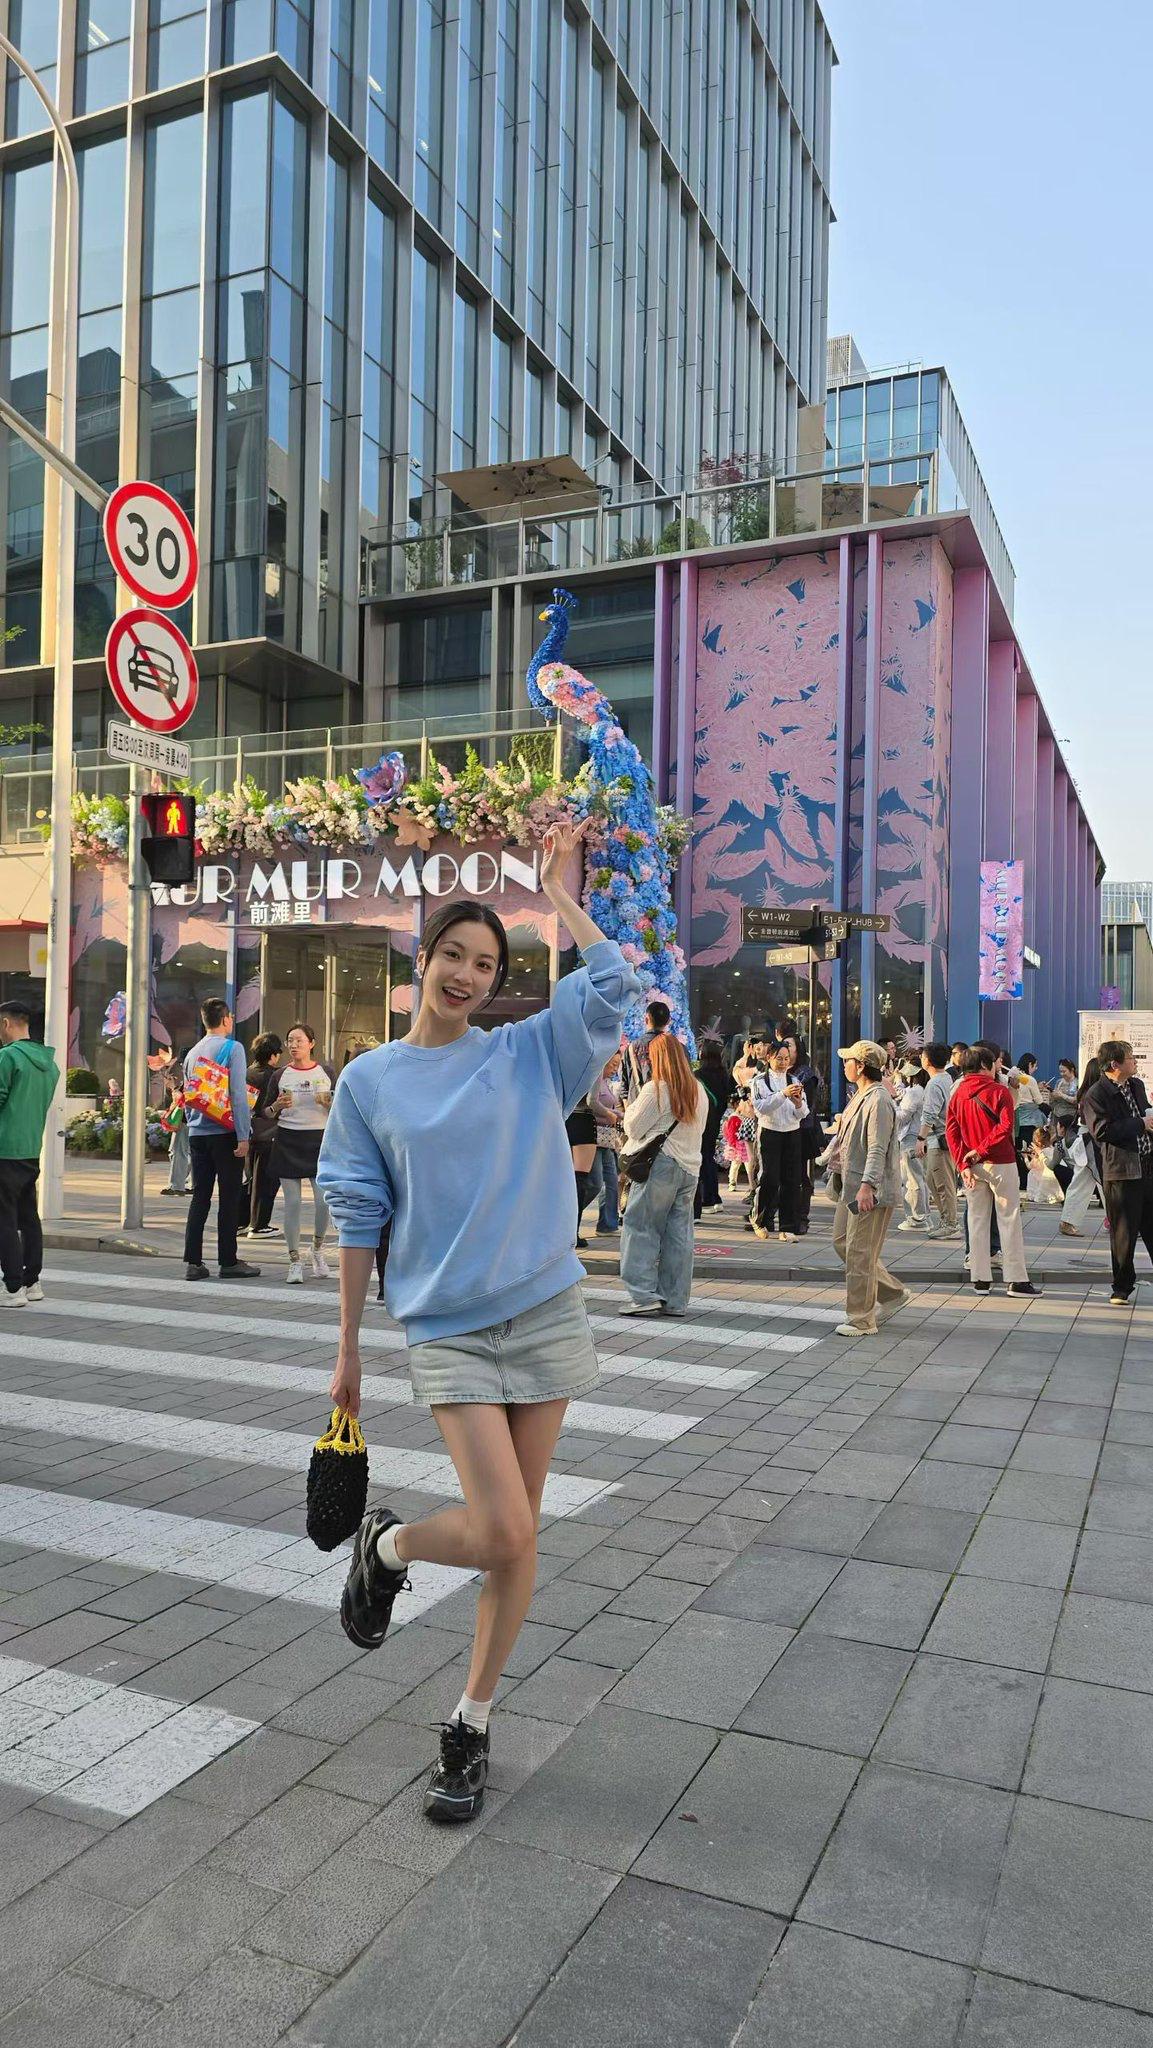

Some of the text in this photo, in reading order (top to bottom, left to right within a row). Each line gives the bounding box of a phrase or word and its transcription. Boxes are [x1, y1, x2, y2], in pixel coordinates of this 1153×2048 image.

[125, 512, 181, 580] 30
[246, 858, 362, 903] MUR
[374, 850, 539, 898] MOON
[250, 901, 312, 925] 前滩里
[761, 912, 791, 922] W1-W2
